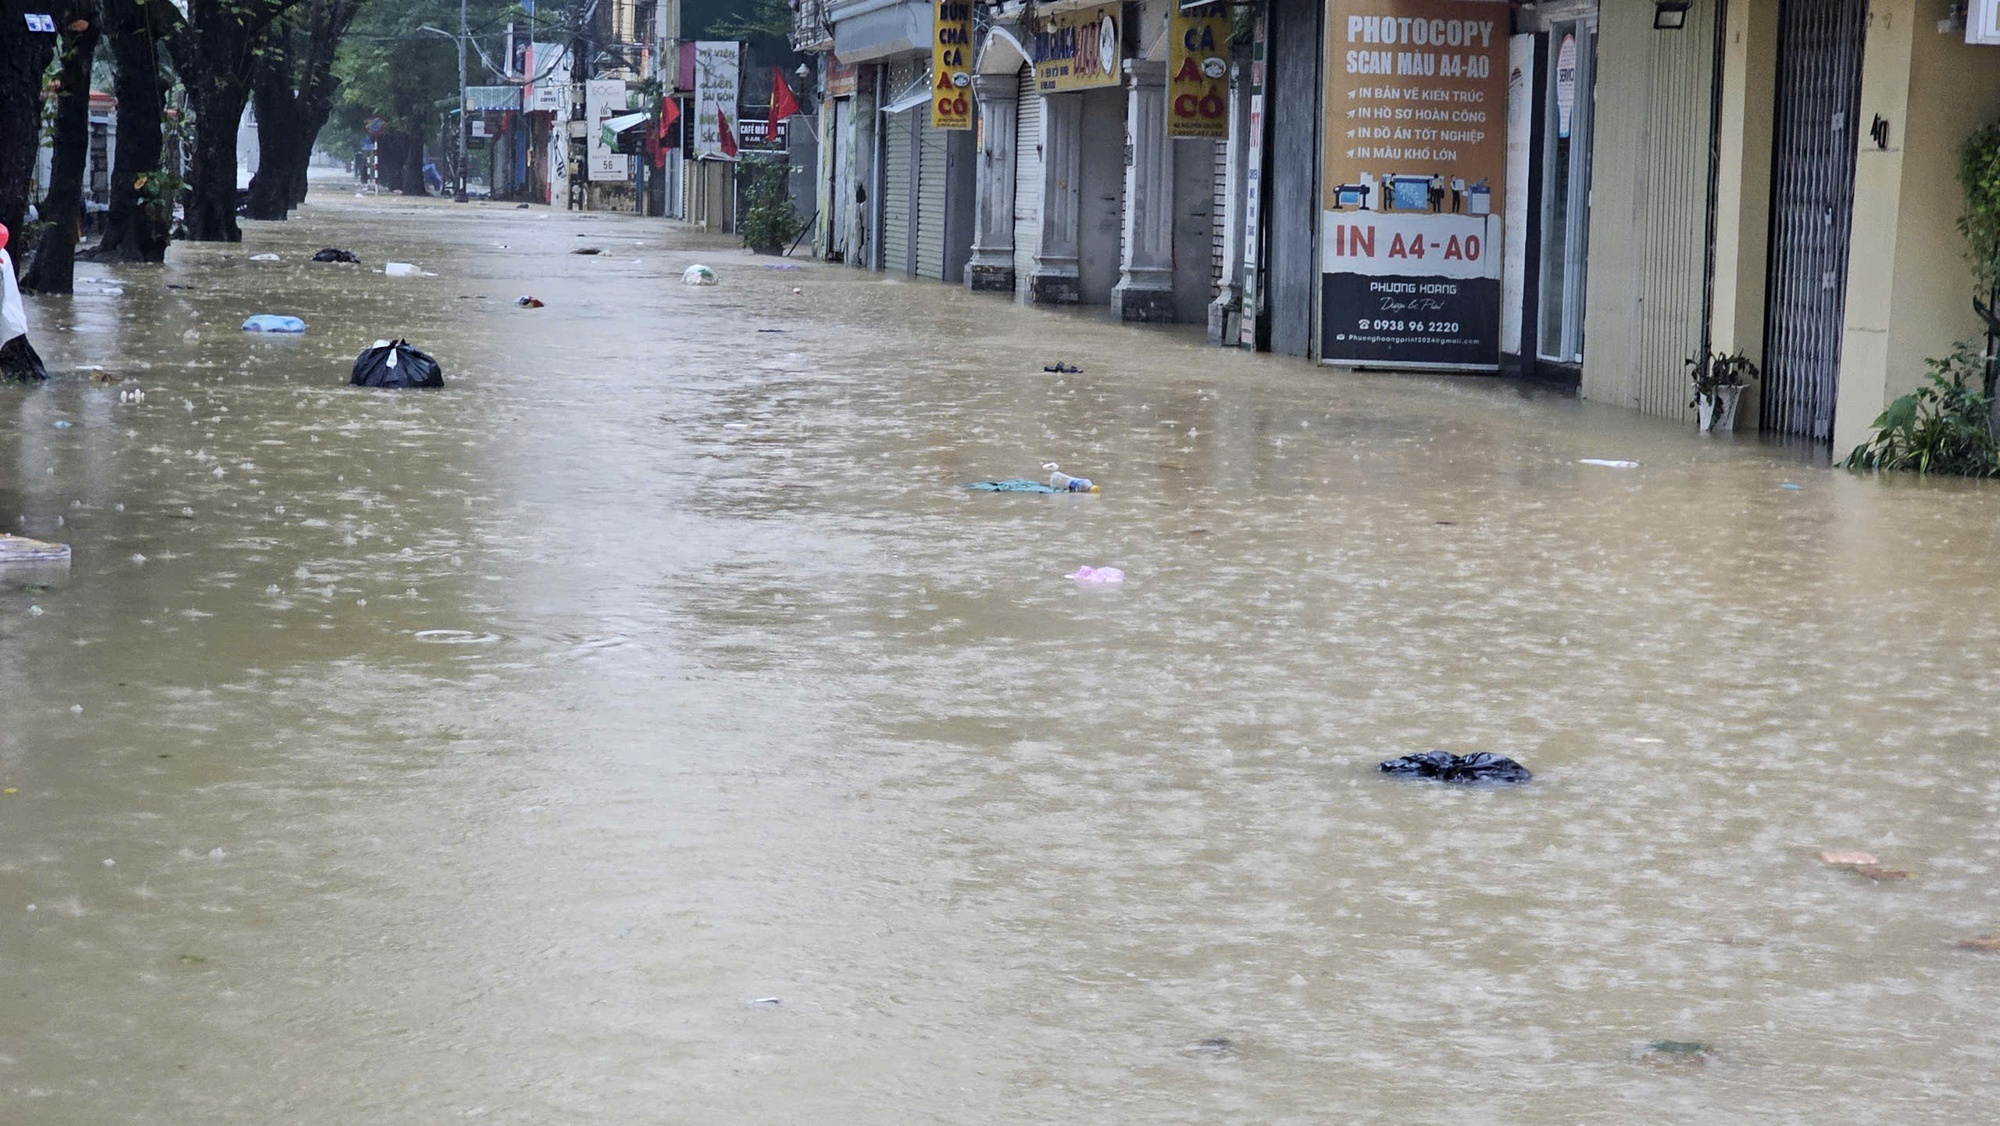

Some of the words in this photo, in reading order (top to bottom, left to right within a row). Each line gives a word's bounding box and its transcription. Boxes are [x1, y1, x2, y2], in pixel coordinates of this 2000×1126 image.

[1347, 15, 1493, 47] PHOTOCOPY
[1346, 50, 1392, 75] SCAN
[1397, 49, 1435, 76] MÀU
[1440, 54, 1489, 79] A4-A0
[1174, 85, 1224, 118] CÓ
[1359, 87, 1372, 99] IN
[1375, 85, 1400, 99] BẢN
[1404, 86, 1419, 99] VẼ
[1422, 88, 1449, 101] KIẾN
[1452, 89, 1484, 102] TRÚC
[938, 92, 968, 115] CÓ
[1358, 107, 1371, 118] IN
[1374, 105, 1392, 118] HỒ
[1395, 108, 1412, 119] SƠ
[1415, 109, 1449, 121] HOÀN
[1452, 110, 1486, 122] CÔNG
[1358, 127, 1371, 138] IN
[1373, 125, 1391, 138] ĐỒ
[1394, 127, 1412, 139] ÁN
[1414, 126, 1437, 141] TỐT
[1440, 129, 1485, 144] NGHIỆP
[1357, 146, 1370, 158] IN
[1373, 145, 1401, 159] MÀU
[1404, 146, 1430, 160] KHỔ
[1433, 149, 1457, 161] LỚN
[603, 160, 613, 170] 56
[1336, 224, 1375, 257] IN
[1374, 319, 1405, 331] 0938
[1408, 321, 1425, 332] 96
[1428, 321, 1459, 333] 2220
